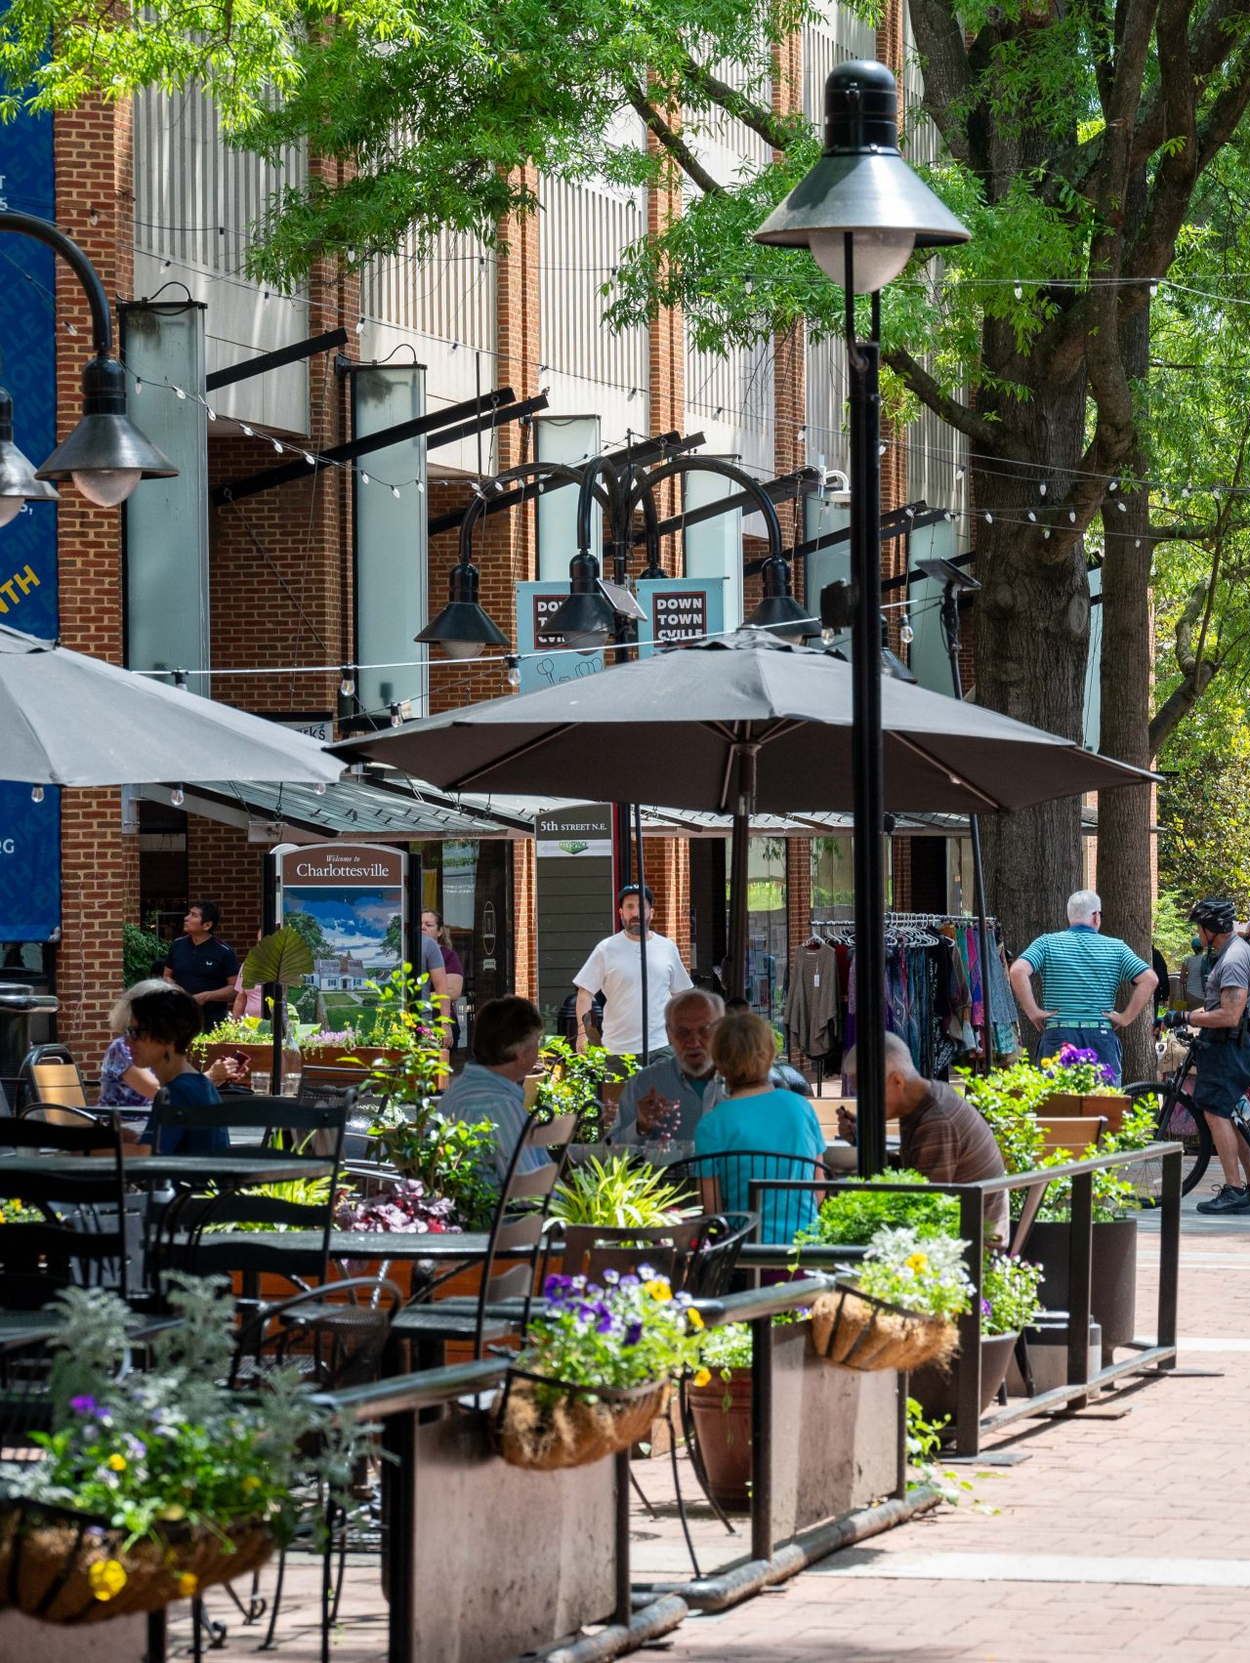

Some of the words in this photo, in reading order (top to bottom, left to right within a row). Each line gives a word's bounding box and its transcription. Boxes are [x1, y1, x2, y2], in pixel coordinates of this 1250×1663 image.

[538, 601, 563, 612] DO
[657, 598, 702, 610] DOWN
[657, 613, 702, 625] TOWN
[658, 629, 702, 641] CVILLE
[540, 821, 558, 831] 5th
[591, 823, 608, 831] N.E.
[326, 854, 353, 863] Welcome
[353, 855, 361, 863] to
[296, 863, 390, 877] Charlottesville
